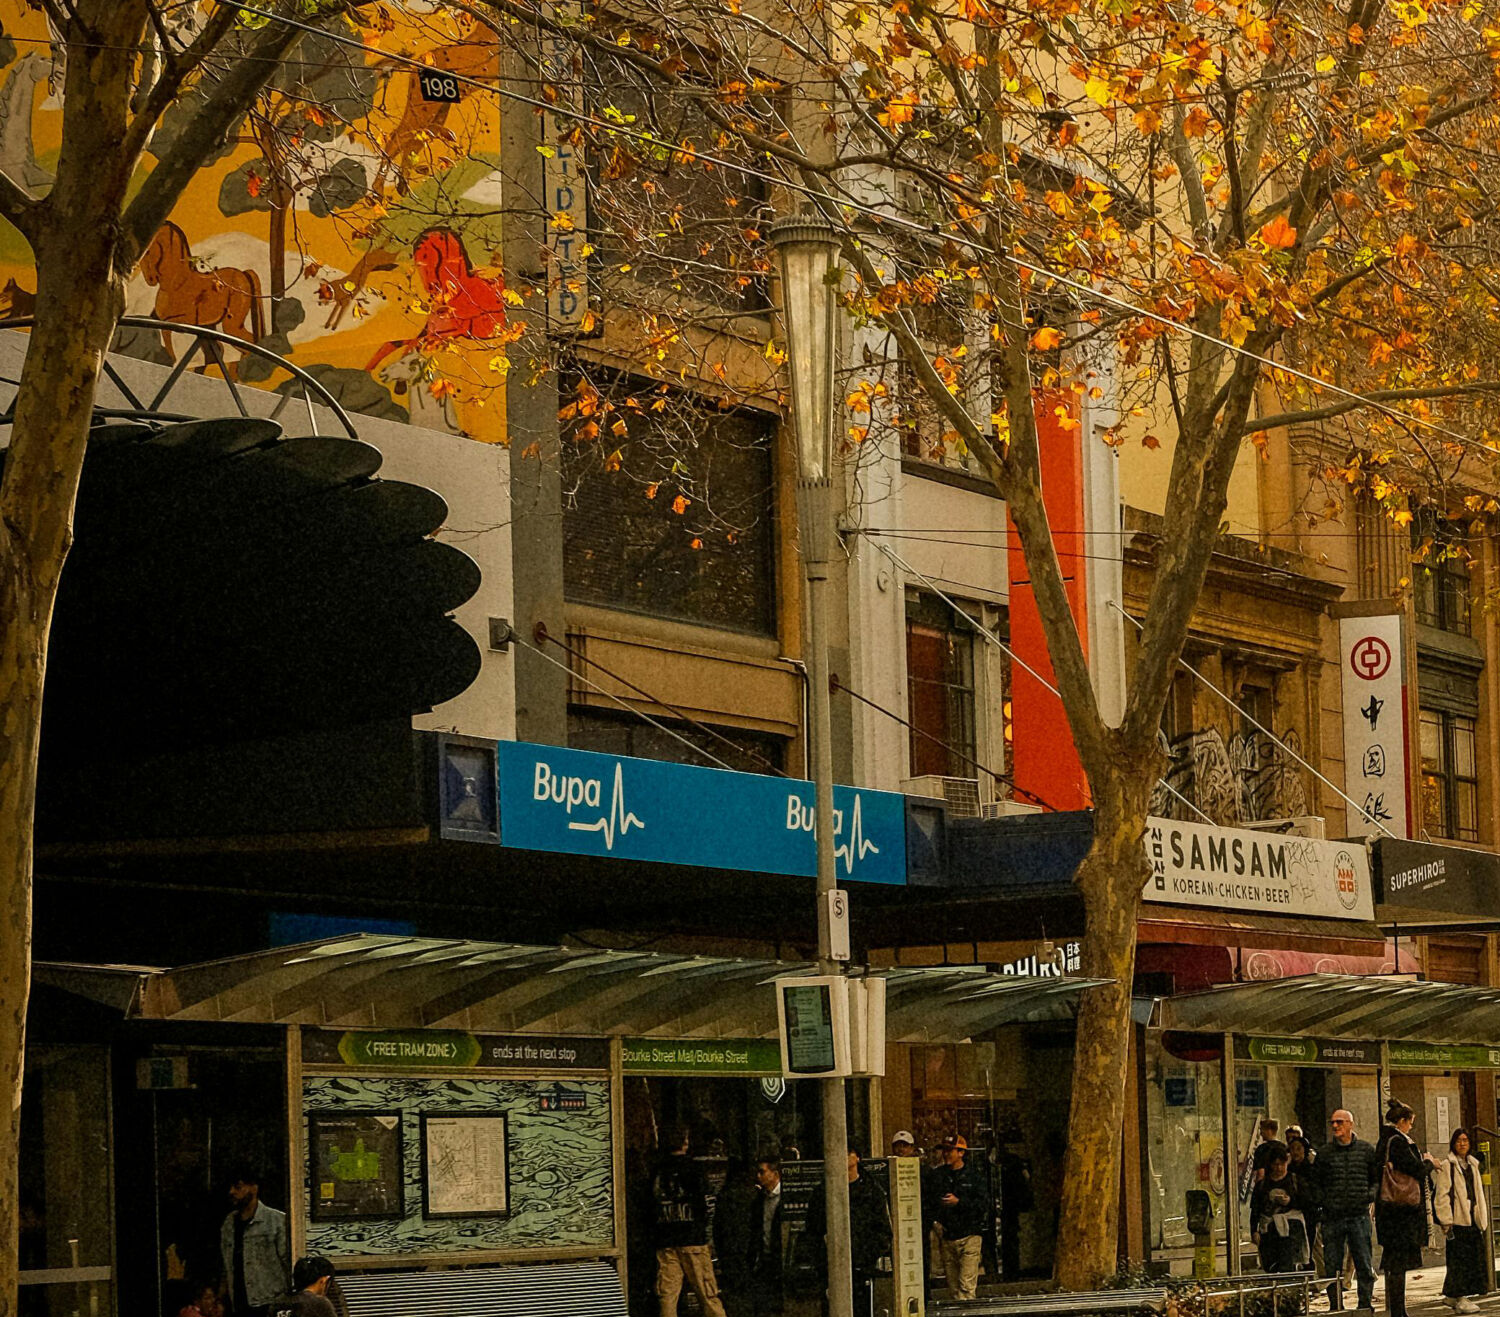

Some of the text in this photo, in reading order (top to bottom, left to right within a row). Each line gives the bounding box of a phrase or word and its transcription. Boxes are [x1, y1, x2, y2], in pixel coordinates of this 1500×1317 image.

[421, 77, 457, 99] 198
[533, 762, 601, 814] Bupa
[786, 795, 843, 842] Bua
[1169, 830, 1288, 880] SAMSAM
[1390, 861, 1439, 892] SUPERHIRO
[1173, 877, 1214, 896] KOREAN
[1219, 882, 1261, 901] CHICKEN
[1265, 886, 1291, 904] BEER
[373, 1042, 450, 1057] FREE TRAM ZONE
[492, 1045, 577, 1063] ends at the next stop
[621, 1048, 650, 1062] Bourke
[652, 1048, 676, 1063] Street
[725, 1050, 749, 1064] Street
